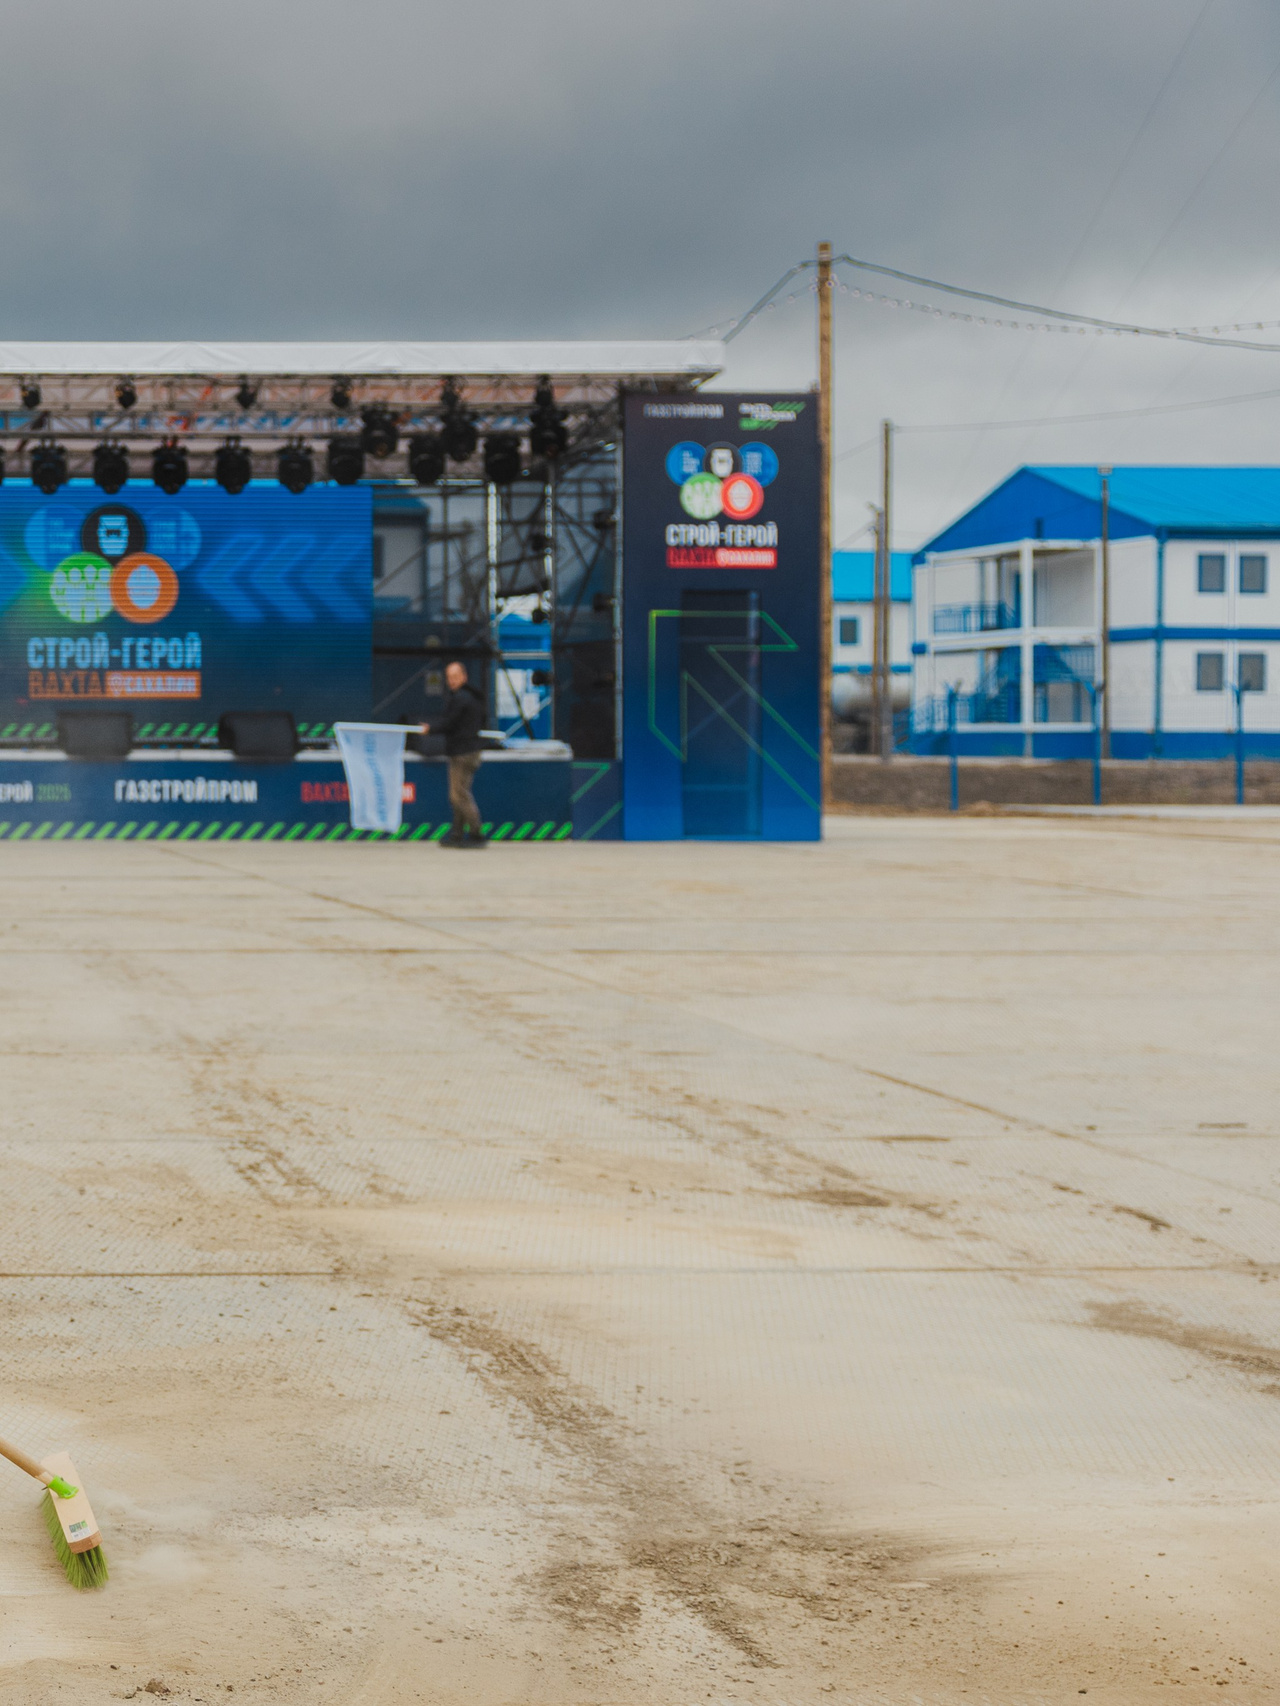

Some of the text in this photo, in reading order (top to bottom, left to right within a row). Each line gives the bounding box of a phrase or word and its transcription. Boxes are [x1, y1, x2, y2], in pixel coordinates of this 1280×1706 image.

[665, 521, 778, 547] СТРОЙ-ГЕРОЙ
[27, 632, 202, 669] СТРОЙ-ГЕРОЙ
[29, 670, 197, 695] ВАХТА САХАЛИН
[115, 776, 258, 803] ГАЗСТРОЙПРОМ
